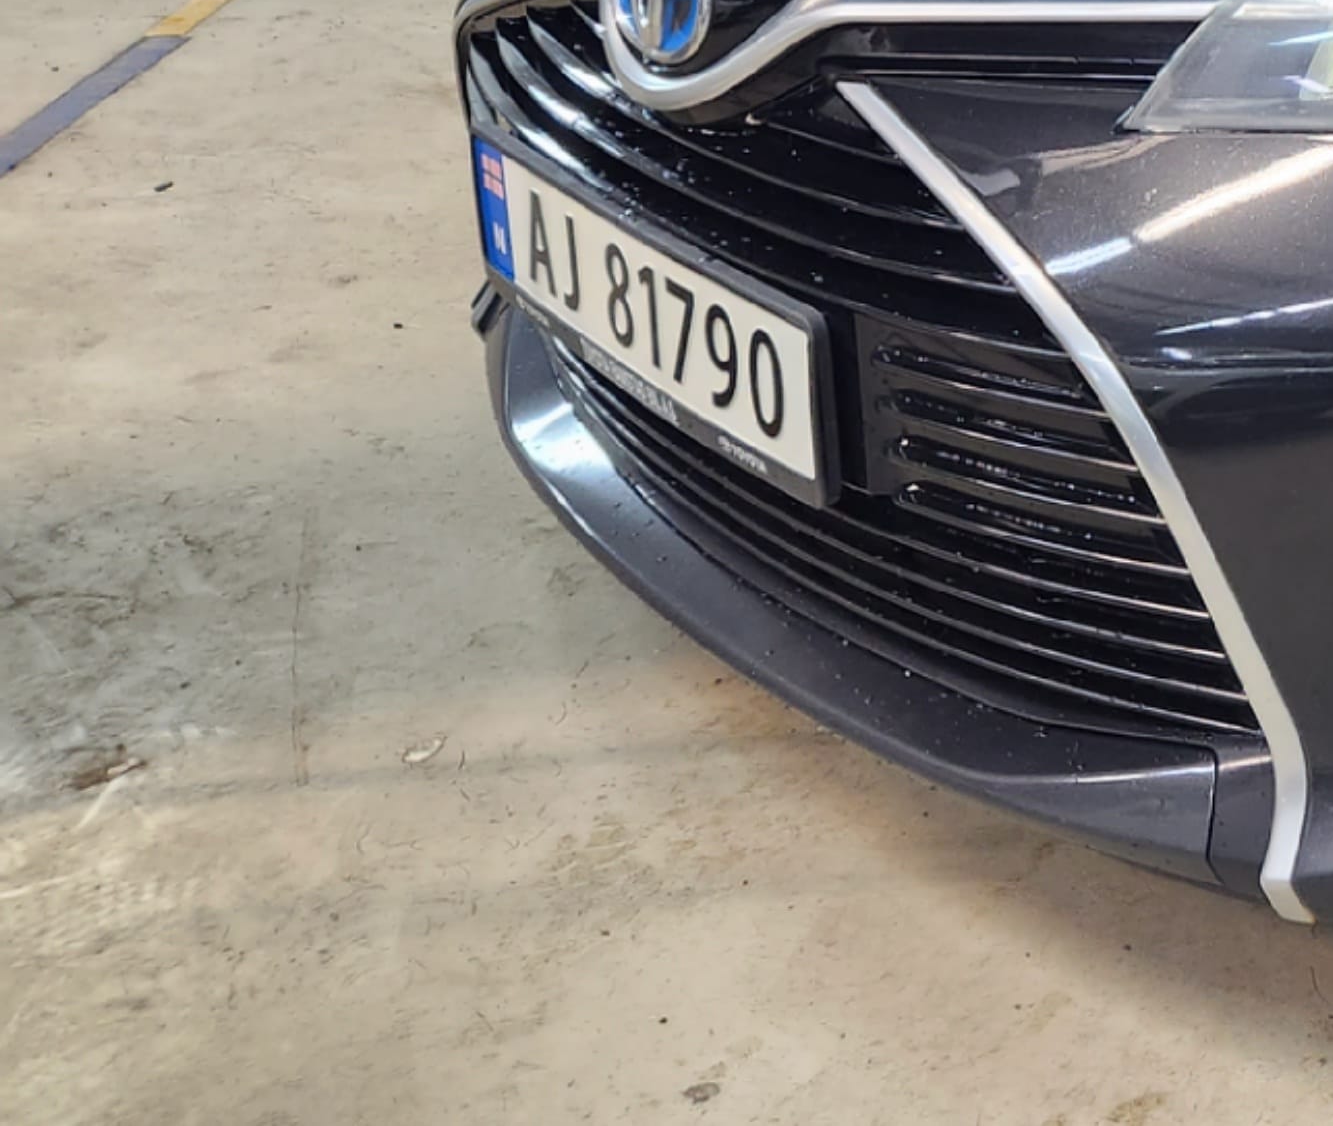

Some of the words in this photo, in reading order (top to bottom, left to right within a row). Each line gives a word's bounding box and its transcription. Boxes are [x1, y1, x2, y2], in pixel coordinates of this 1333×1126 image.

[492, 221, 507, 256] N
[528, 191, 581, 312] AJ
[604, 242, 785, 439] 81790
